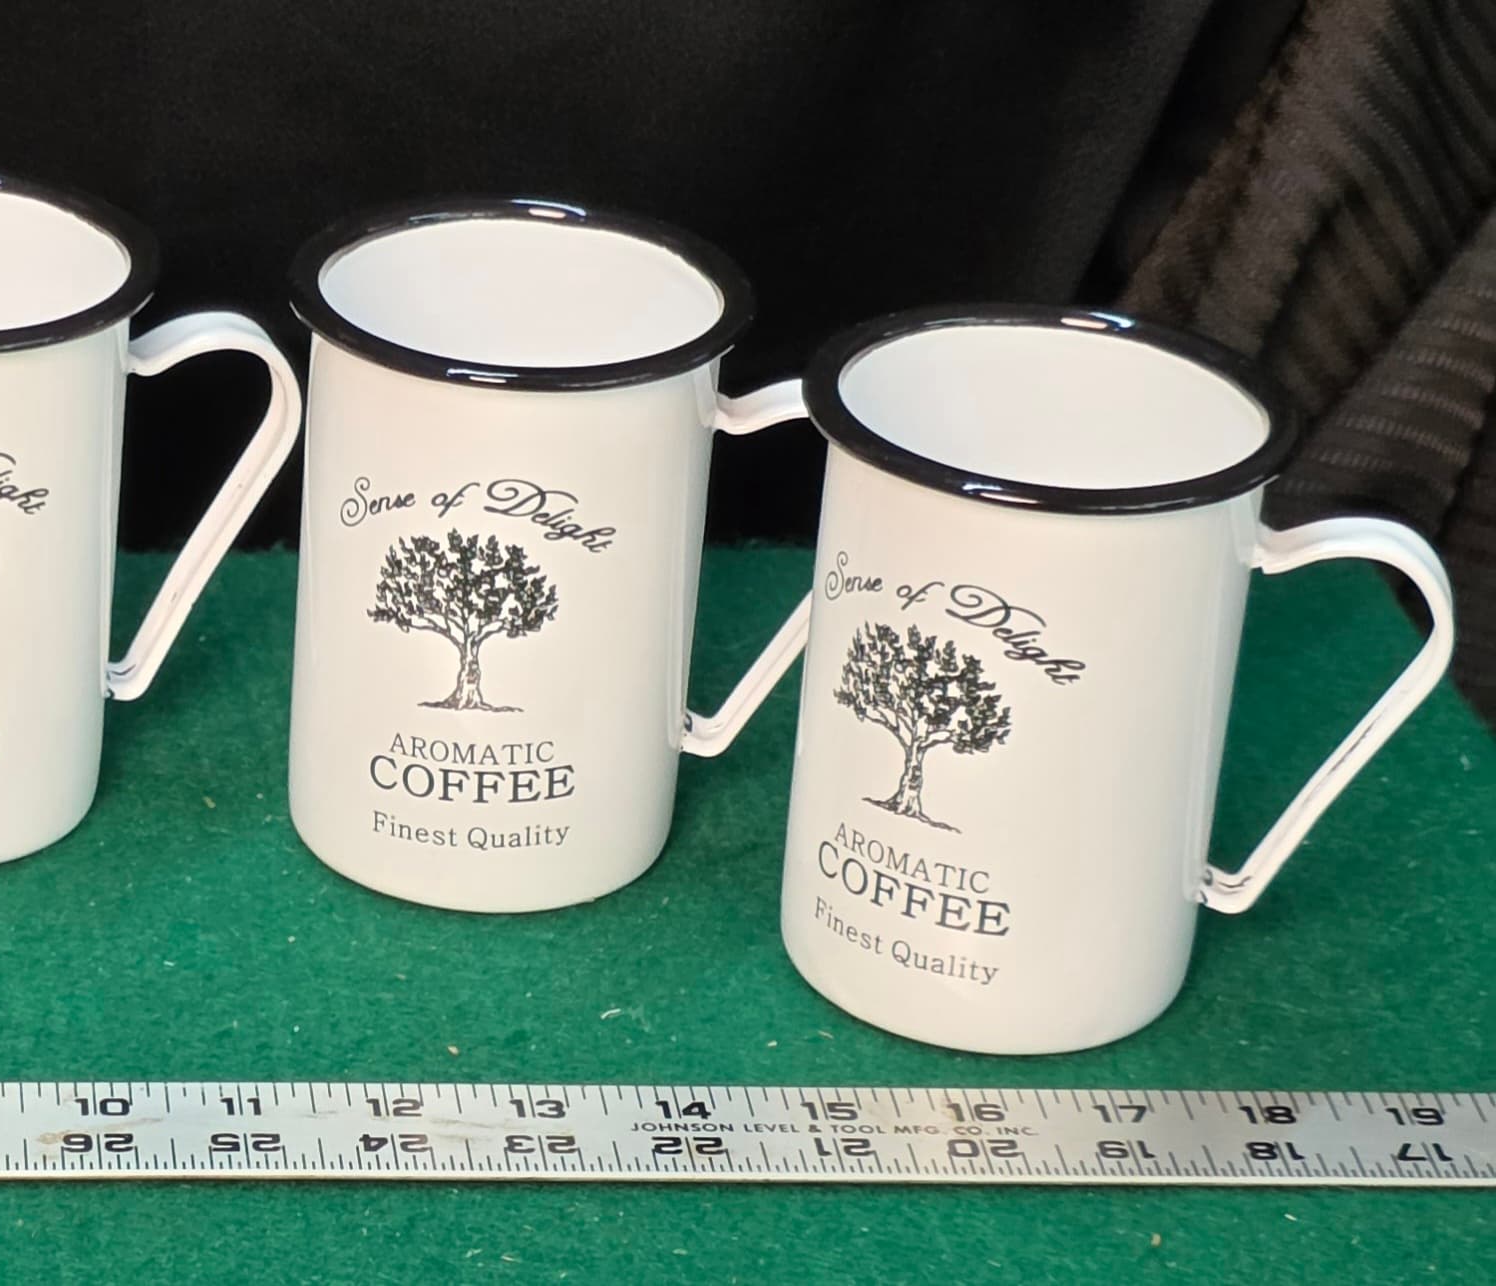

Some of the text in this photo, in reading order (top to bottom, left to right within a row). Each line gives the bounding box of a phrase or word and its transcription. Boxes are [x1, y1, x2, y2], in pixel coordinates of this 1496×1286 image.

[340, 476, 616, 554] Sense of Delight
[825, 551, 1087, 686] Sense of Delight
[369, 754, 576, 804] COFFEE
[389, 732, 555, 765] AROMATIC
[373, 810, 571, 851] Finest Quality
[834, 821, 991, 895] AROMATIC
[818, 840, 1012, 937] COFFEE
[814, 896, 1000, 985] Finest Quality
[75, 1098, 130, 1116] 10
[220, 1098, 262, 1116] 11
[366, 1099, 422, 1117] 12
[509, 1099, 566, 1119] 13
[656, 1100, 712, 1119] 14
[801, 1102, 858, 1121] 15
[947, 1103, 1005, 1122] 16
[1093, 1105, 1147, 1123] 17
[1239, 1106, 1297, 1124] 18
[1386, 1107, 1445, 1126] 19
[631, 1122, 734, 1132] JOHNSON
[743, 1123, 800, 1133] LEVEL
[808, 1124, 822, 1133] &
[830, 1124, 885, 1135] TOOL
